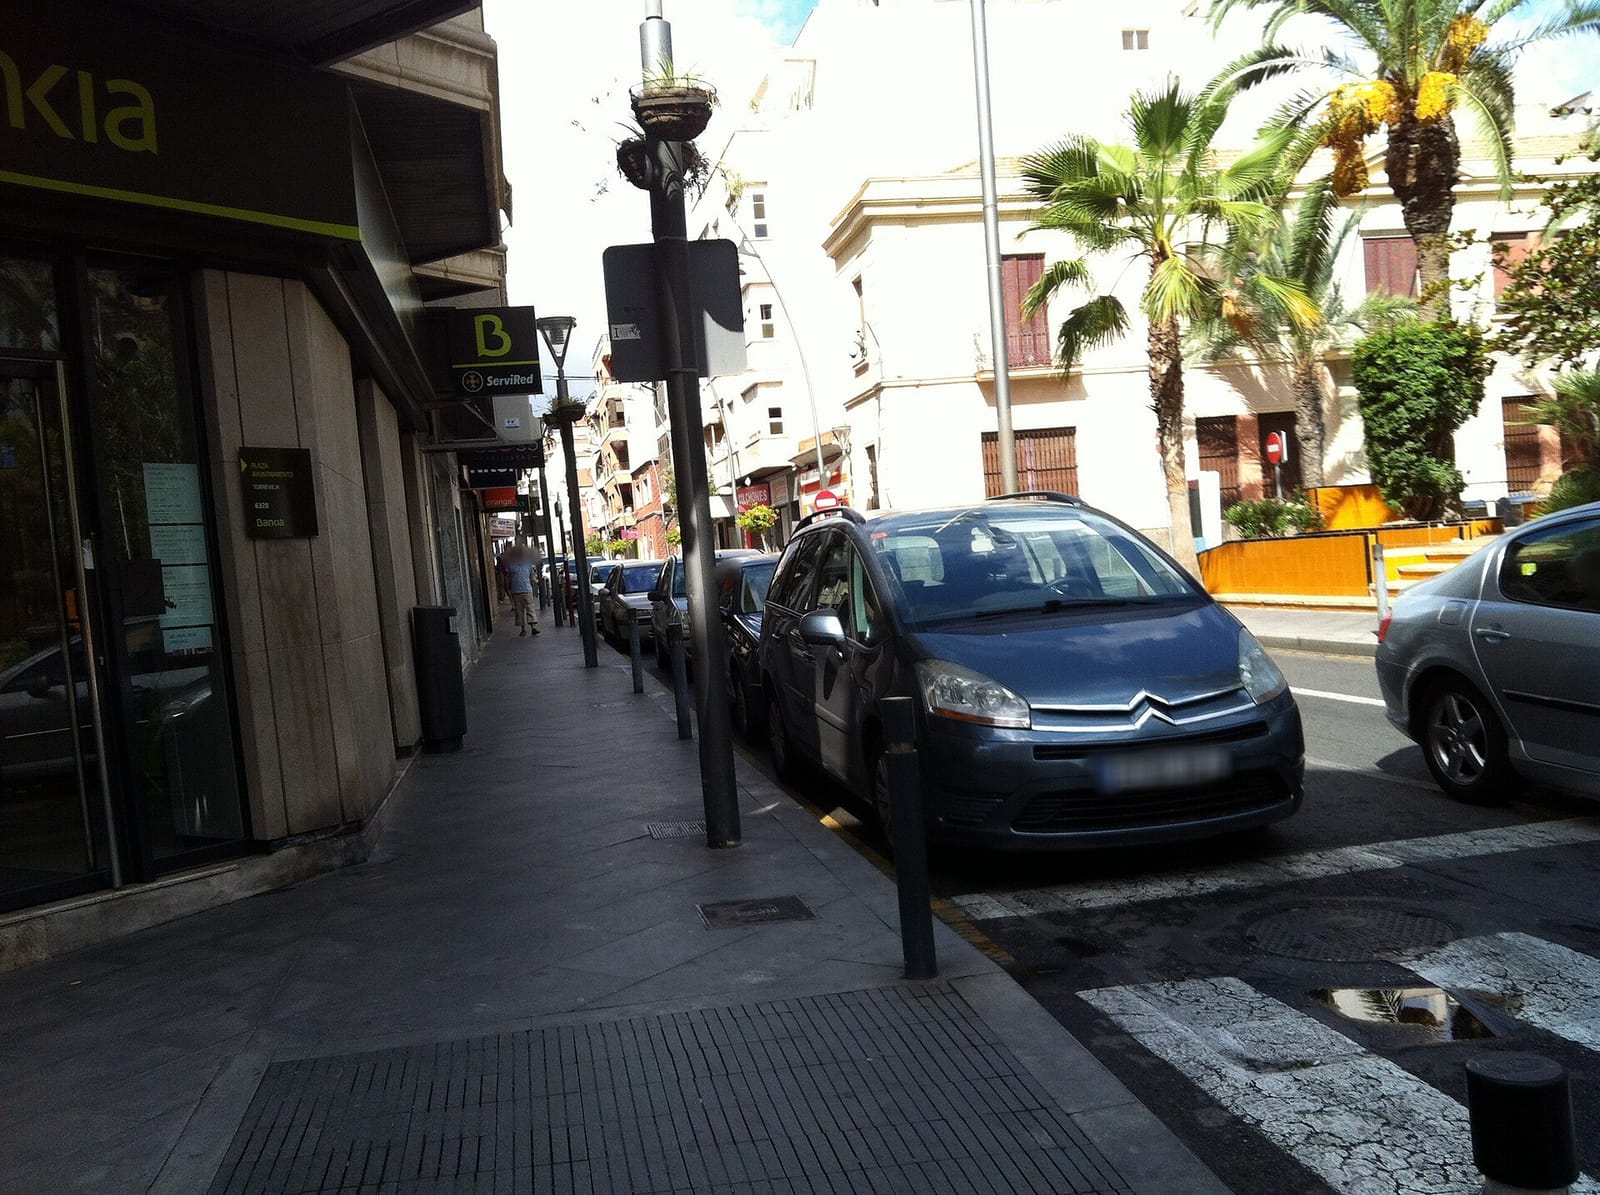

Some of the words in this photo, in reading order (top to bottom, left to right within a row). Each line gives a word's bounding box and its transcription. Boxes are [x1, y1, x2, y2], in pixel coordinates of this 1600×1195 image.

[473, 313, 512, 358] B
[486, 373, 534, 387] ServiRed
[486, 498, 513, 507] orange
